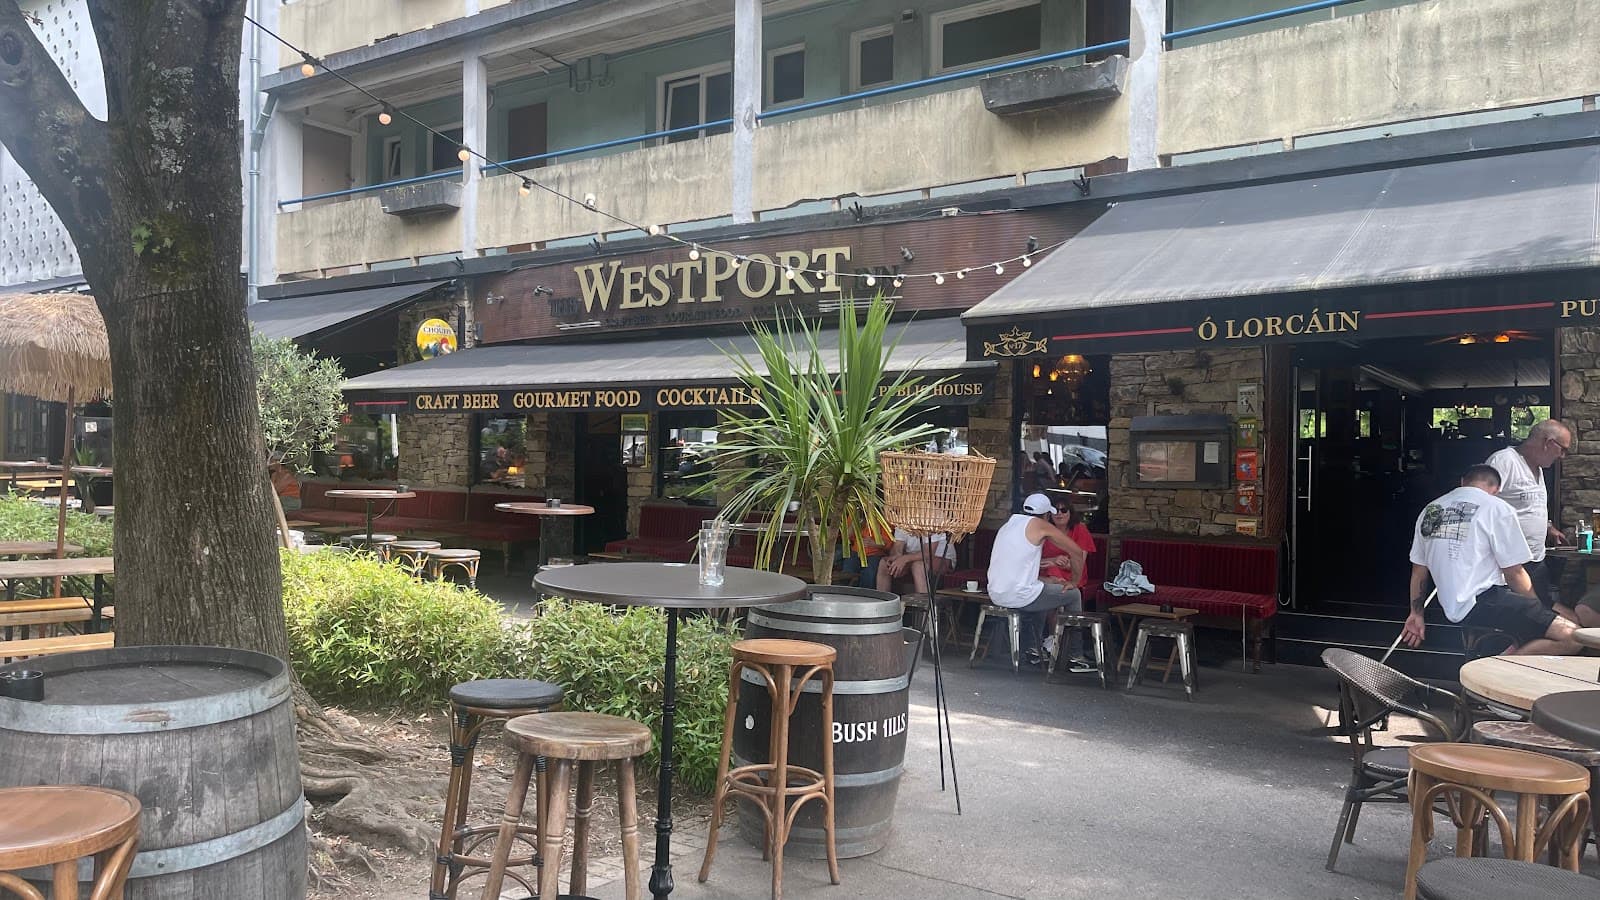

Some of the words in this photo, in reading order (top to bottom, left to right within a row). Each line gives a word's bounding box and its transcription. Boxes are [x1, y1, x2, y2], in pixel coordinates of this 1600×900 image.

[574, 246, 851, 314] WESTPORT
[1560, 298, 1600, 318] PU
[1198, 316, 1218, 341] Ó
[1225, 308, 1361, 339] LORCÁIN
[415, 394, 460, 410] CRAFT
[462, 393, 500, 409] BEER
[513, 391, 591, 409] GOURMET
[594, 389, 641, 408] FOOD
[656, 387, 762, 407] COCKTAILS
[933, 382, 983, 396] HOUSE
